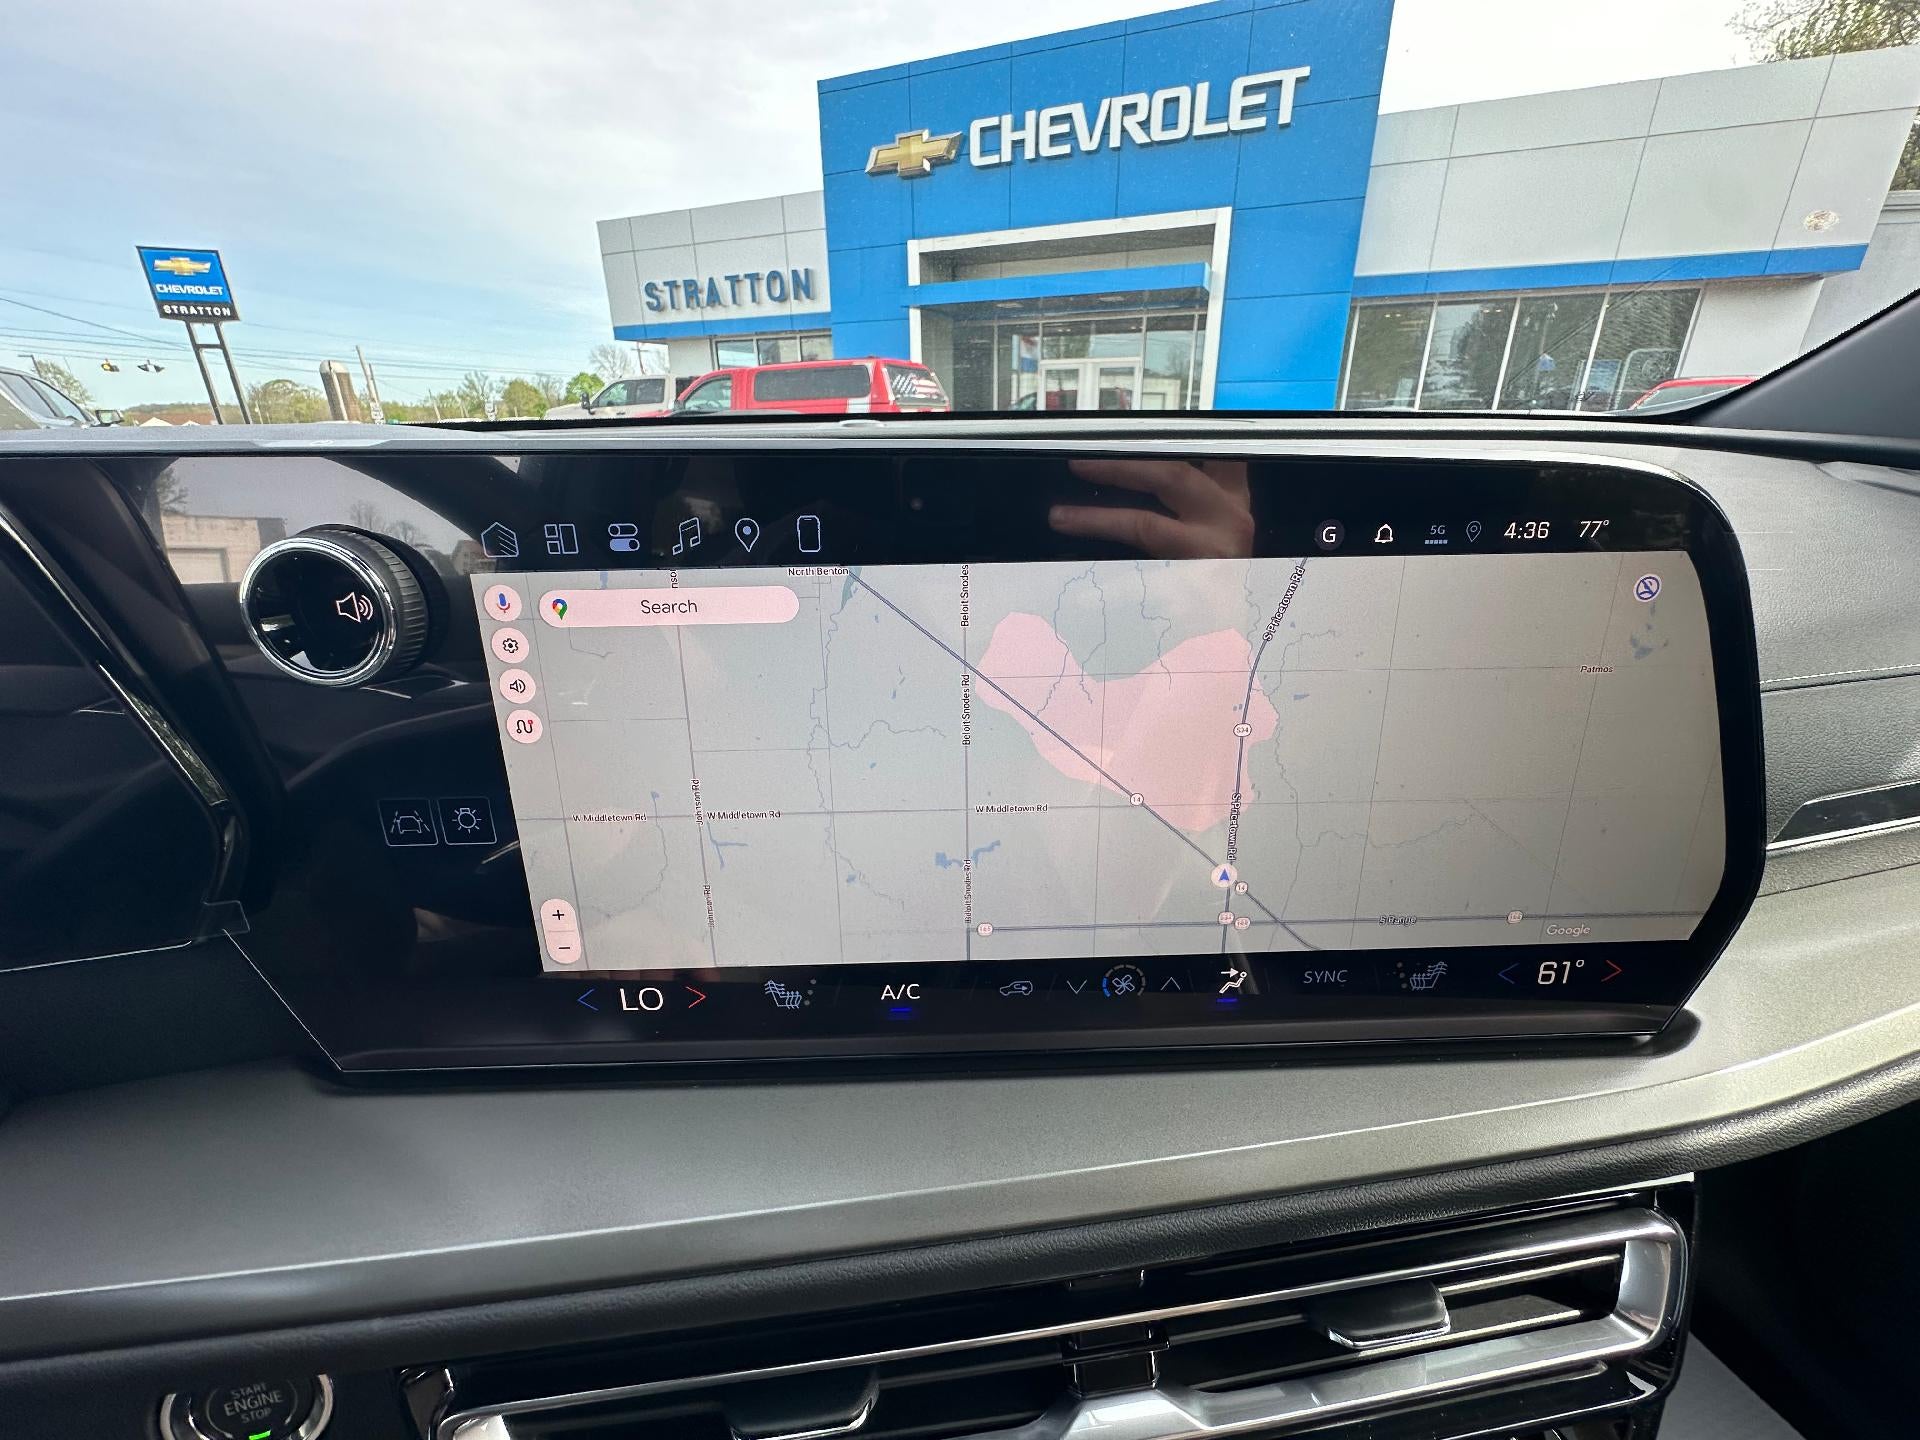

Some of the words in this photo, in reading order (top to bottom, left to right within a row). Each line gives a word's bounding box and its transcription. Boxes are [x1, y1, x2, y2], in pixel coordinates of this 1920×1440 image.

[969, 65, 1311, 167] CHEVROLET
[155, 284, 223, 295] CHEVROLET
[644, 267, 814, 312] STRATTON
[163, 304, 231, 316] STRATTON
[1322, 526, 1336, 543] G
[1430, 525, 1446, 536] 5G
[1503, 521, 1550, 539] 4:36
[1578, 519, 1610, 538] 77°
[788, 567, 815, 576] North
[816, 567, 849, 576] Benton
[960, 564, 969, 600] Snodes
[640, 599, 698, 614] Search
[1266, 582, 1299, 634] Pricetown
[1290, 565, 1306, 583] Rd
[960, 602, 970, 627] Beloit
[1580, 665, 1614, 673] Patmos
[961, 674, 971, 688] Rd
[962, 689, 971, 720] Snodes
[962, 720, 971, 746] Beloit
[691, 779, 700, 791] Rd
[693, 791, 704, 825] Johnson
[707, 811, 716, 820] W
[718, 811, 767, 820] Middletown
[769, 810, 781, 819] Rd
[976, 805, 984, 813] W
[985, 804, 1035, 813] Middletown
[1036, 804, 1048, 812] Rd
[572, 814, 581, 822] W
[583, 814, 633, 822] Middletown
[634, 813, 647, 821] Rd
[1228, 801, 1242, 848] Pricetown
[1227, 848, 1238, 861] Rd
[1546, 923, 1591, 937] Google
[1303, 969, 1348, 984] SYNC
[1536, 959, 1585, 985] 61°
[619, 987, 664, 1011] LO
[880, 983, 921, 1000] A/C
[230, 1382, 267, 1399] START
[223, 1390, 283, 1416] ENGINE
[240, 1407, 272, 1423] STOP
